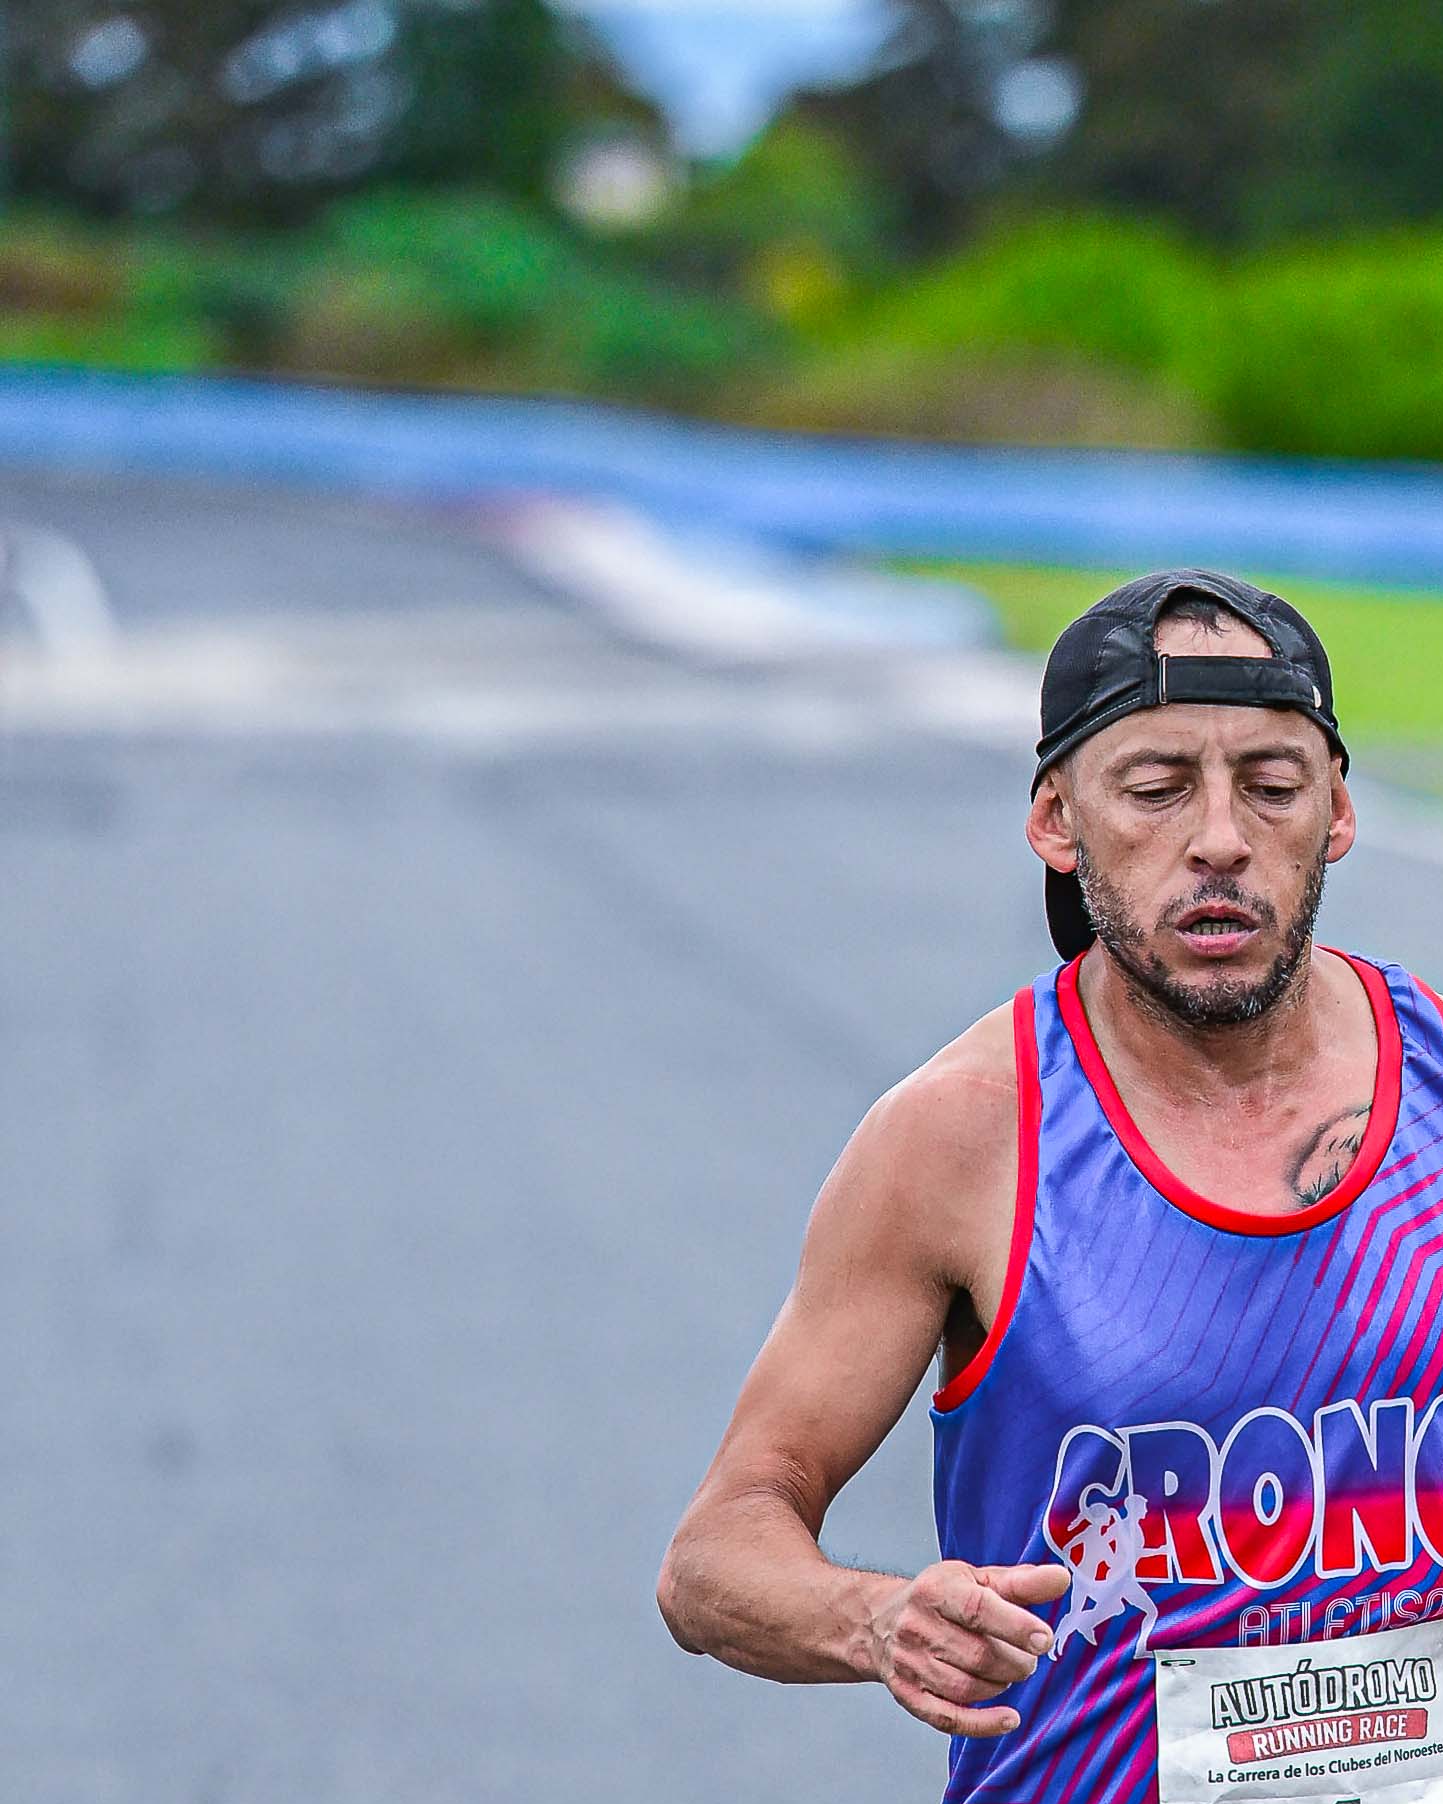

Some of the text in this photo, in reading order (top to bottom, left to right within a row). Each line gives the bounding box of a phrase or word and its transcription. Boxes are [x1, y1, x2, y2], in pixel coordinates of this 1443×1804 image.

[1211, 1658, 1438, 1729] AUTÓDROMO
[1252, 1713, 1408, 1759] RUNNING RACE
[1208, 1742, 1443, 1784] La Carrera de los Clubes del Noroeste
